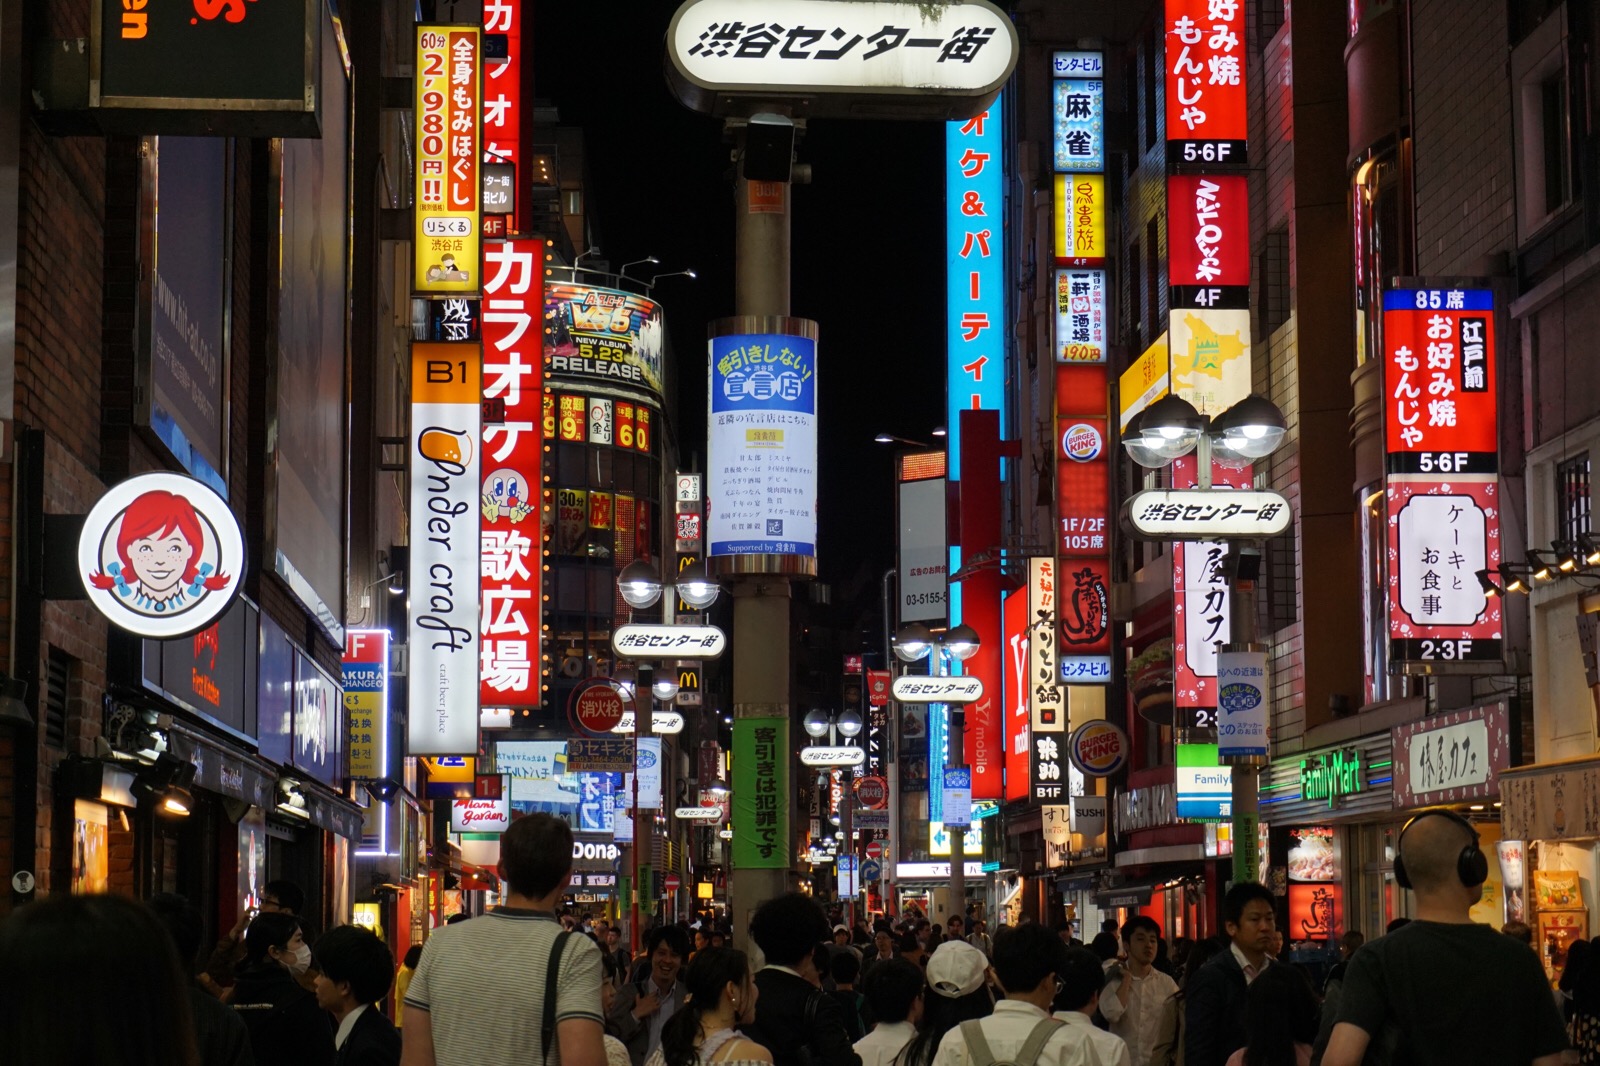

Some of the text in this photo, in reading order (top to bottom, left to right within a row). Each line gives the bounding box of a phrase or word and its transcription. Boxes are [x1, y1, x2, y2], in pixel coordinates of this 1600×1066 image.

[420, 33, 446, 49] 60分
[688, 21, 997, 63] 渋谷センター街
[1054, 58, 1102, 71] センタービル
[1174, 16, 1207, 130] もんじゃ
[1088, 82, 1102, 91] 5F
[451, 37, 475, 206] 全身もみほぐし
[1066, 93, 1092, 156] 麻雀
[427, 221, 467, 232] りらくる
[484, 221, 502, 234] 4F
[431, 239, 463, 251] 渋谷店
[1074, 258, 1087, 266] 4F
[1195, 289, 1221, 306] 4F
[576, 337, 626, 350] NEW ALBUM
[580, 344, 624, 362] 5.23
[1463, 321, 1484, 388] 江戸前
[427, 361, 466, 384] B1
[552, 356, 641, 380] RELEASE
[1427, 314, 1456, 427] お好み焼
[726, 373, 801, 399] 宣言店
[1394, 346, 1423, 448] もんじゃ
[1068, 432, 1095, 445] BURGER
[1069, 438, 1096, 453] KING
[560, 491, 584, 507] 30分
[1139, 503, 1283, 522] 渋谷センター街
[728, 544, 774, 555] Supported by
[1064, 536, 1104, 549] 105席
[1447, 504, 1466, 591] ケーキと
[1421, 547, 1442, 616] お食事
[416, 563, 473, 653] craft
[481, 529, 532, 693] 歌広場
[618, 634, 719, 648] 渋谷センター街
[1061, 662, 1110, 676] センタービル
[439, 687, 449, 707] beer
[898, 683, 980, 695] 渋谷センター街
[581, 700, 620, 718] 消火栓
[585, 741, 633, 756] セキネ
[1079, 732, 1118, 750] BURGER
[804, 750, 860, 760] 渋谷センター街
[976, 727, 988, 774] mobile
[1081, 741, 1120, 764] KING
[1300, 750, 1360, 809] FamilyMart
[754, 727, 777, 859] 客引きは犯罪です
[861, 788, 882, 798] 消火栓
[1037, 788, 1062, 798] B1F
[1044, 808, 1070, 823] すし
[1076, 808, 1105, 818] SUSHI
[1219, 803, 1231, 816] 酒
